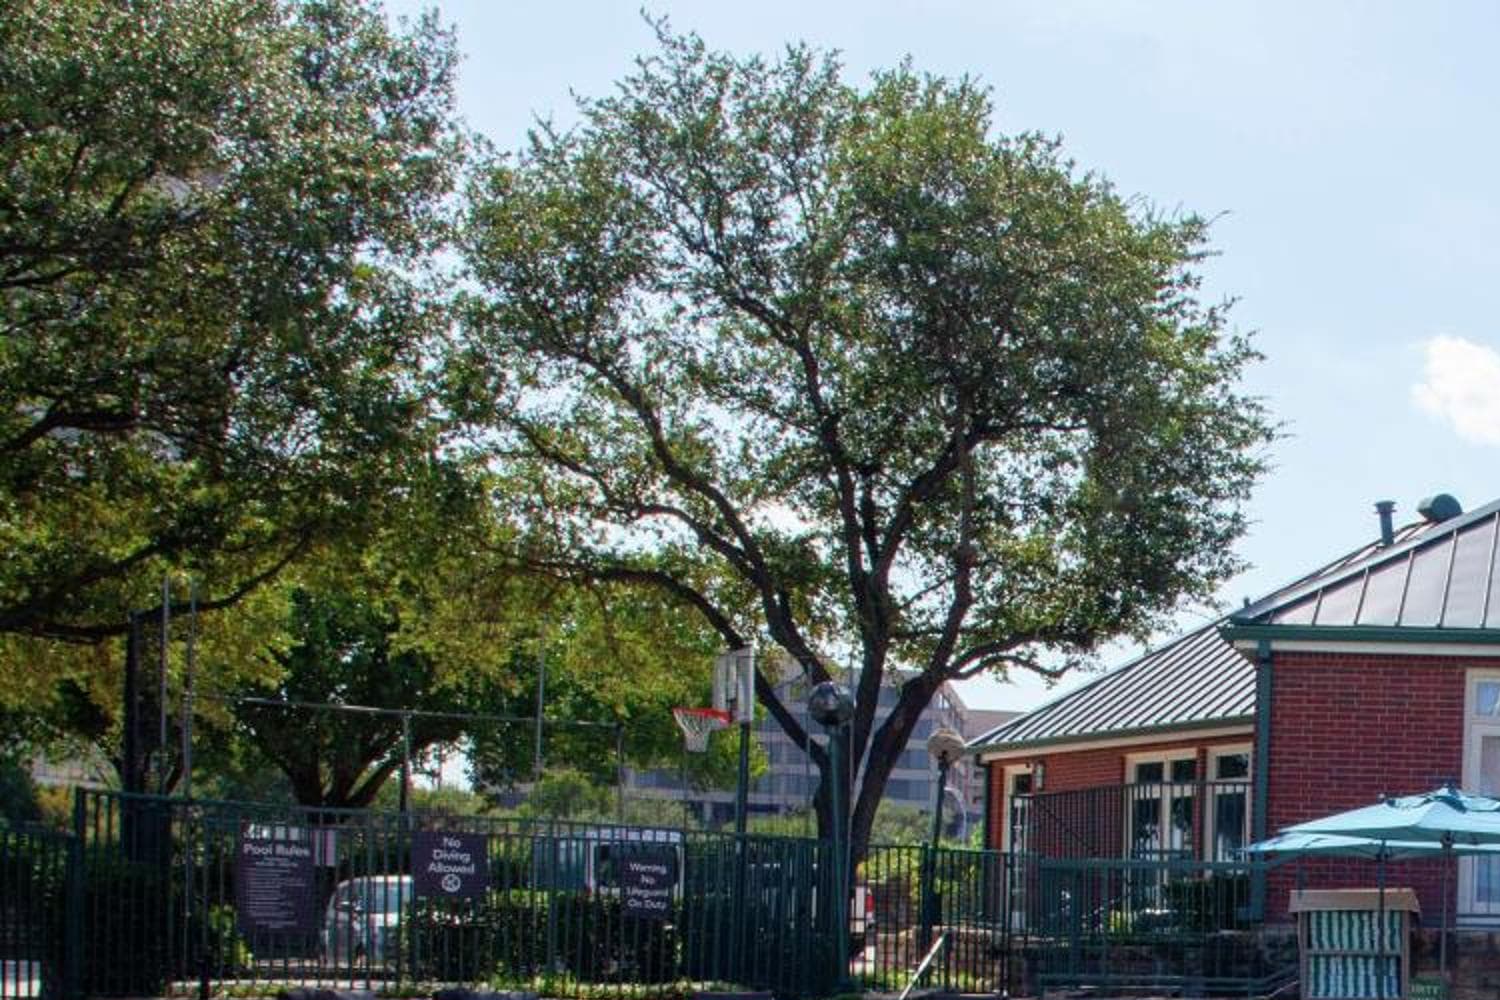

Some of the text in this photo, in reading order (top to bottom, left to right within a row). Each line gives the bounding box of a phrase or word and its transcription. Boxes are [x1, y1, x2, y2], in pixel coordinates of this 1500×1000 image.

[443, 837, 461, 848] No
[243, 843, 310, 857] Pool Rules
[433, 849, 471, 863] Diving
[428, 863, 475, 873] Allowed
[629, 863, 667, 874] Warning
[640, 874, 655, 885] No
[627, 898, 667, 911] On Duty
